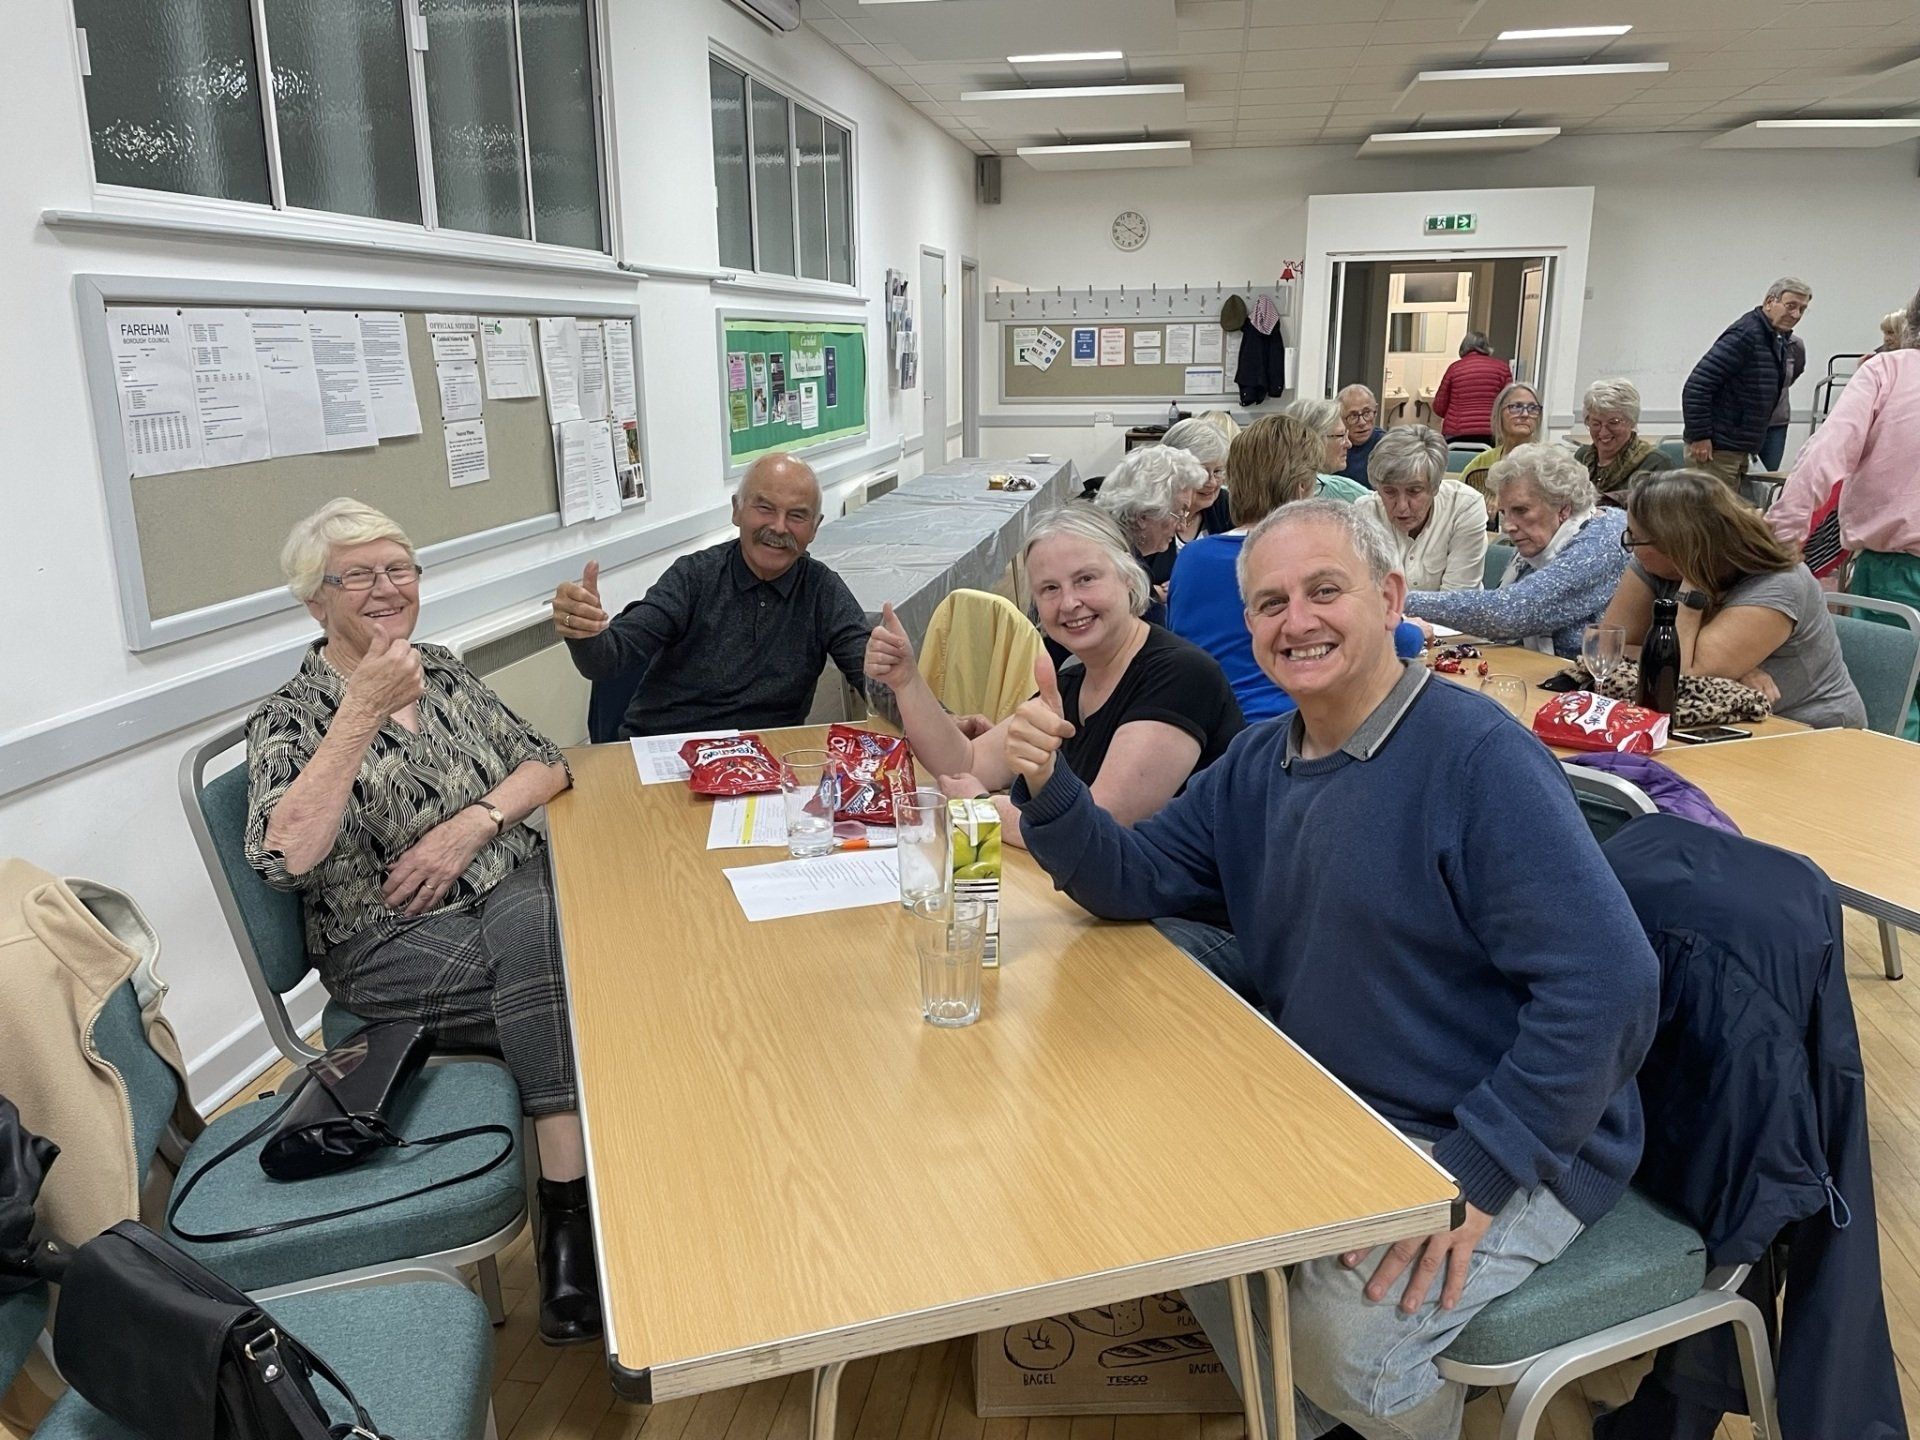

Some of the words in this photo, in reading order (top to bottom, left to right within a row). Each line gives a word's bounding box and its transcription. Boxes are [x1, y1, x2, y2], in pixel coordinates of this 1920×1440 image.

[120, 323, 170, 336] FAREHAM
[1023, 1373, 1056, 1386] BAGEL
[1106, 1375, 1149, 1386] TESCO
